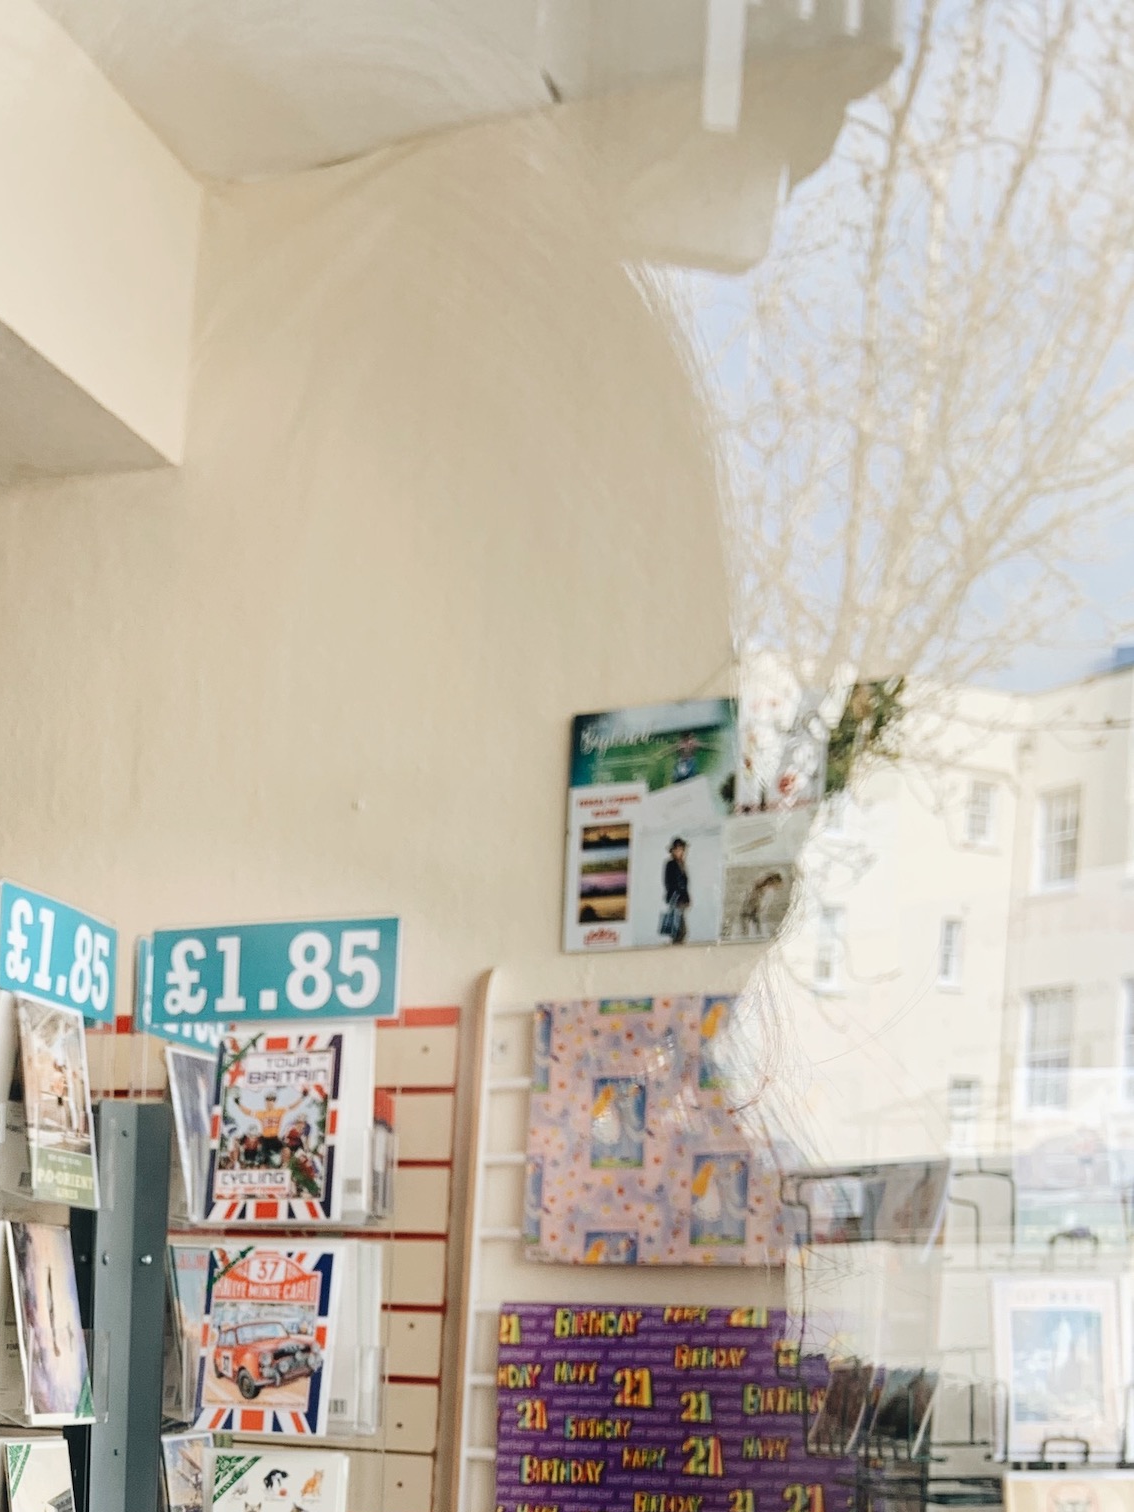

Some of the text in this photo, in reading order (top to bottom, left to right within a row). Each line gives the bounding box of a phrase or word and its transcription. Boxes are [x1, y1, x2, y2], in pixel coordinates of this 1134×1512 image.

[5, 896, 112, 1012] £1.85
[163, 928, 381, 1017] £1.85
[221, 1172, 285, 1185] CYCLING
[256, 1261, 279, 1280] 37
[517, 1399, 549, 1431] 21
[680, 1391, 713, 1424] 21
[681, 1436, 724, 1477] 21
